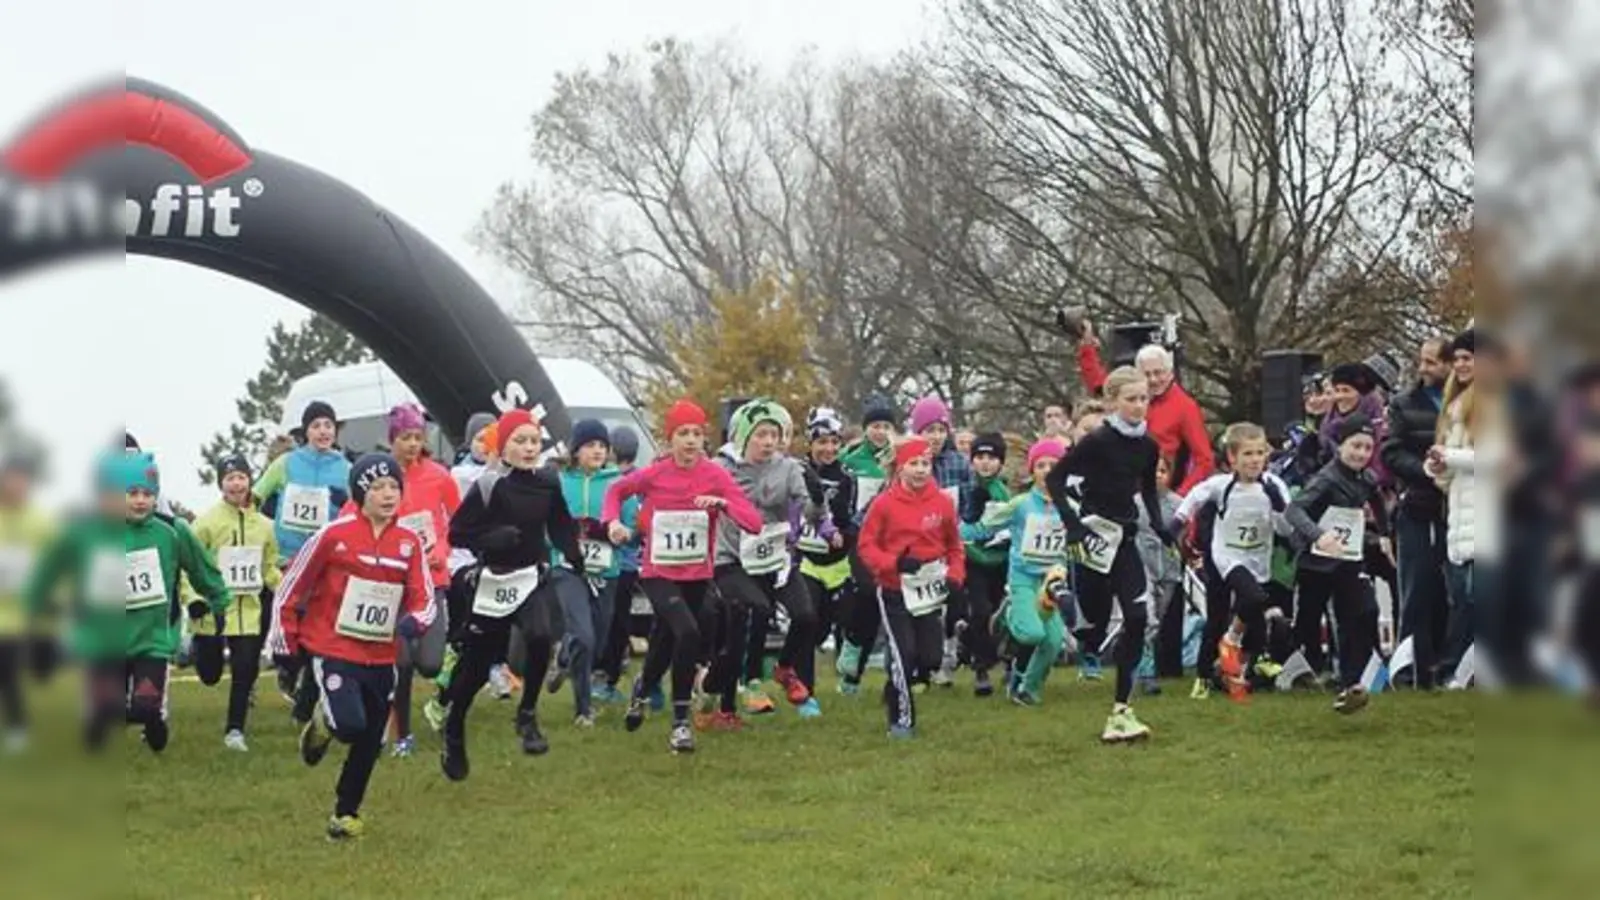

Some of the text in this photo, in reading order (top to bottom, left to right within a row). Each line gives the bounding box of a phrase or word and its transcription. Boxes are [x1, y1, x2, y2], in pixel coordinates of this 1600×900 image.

[356, 461, 390, 492] NYC
[292, 502, 319, 521] 121
[664, 531, 697, 550] 114
[1033, 533, 1063, 551] 117
[1237, 526, 1258, 542] 73
[494, 586, 519, 605] 98
[355, 602, 389, 627] 100
